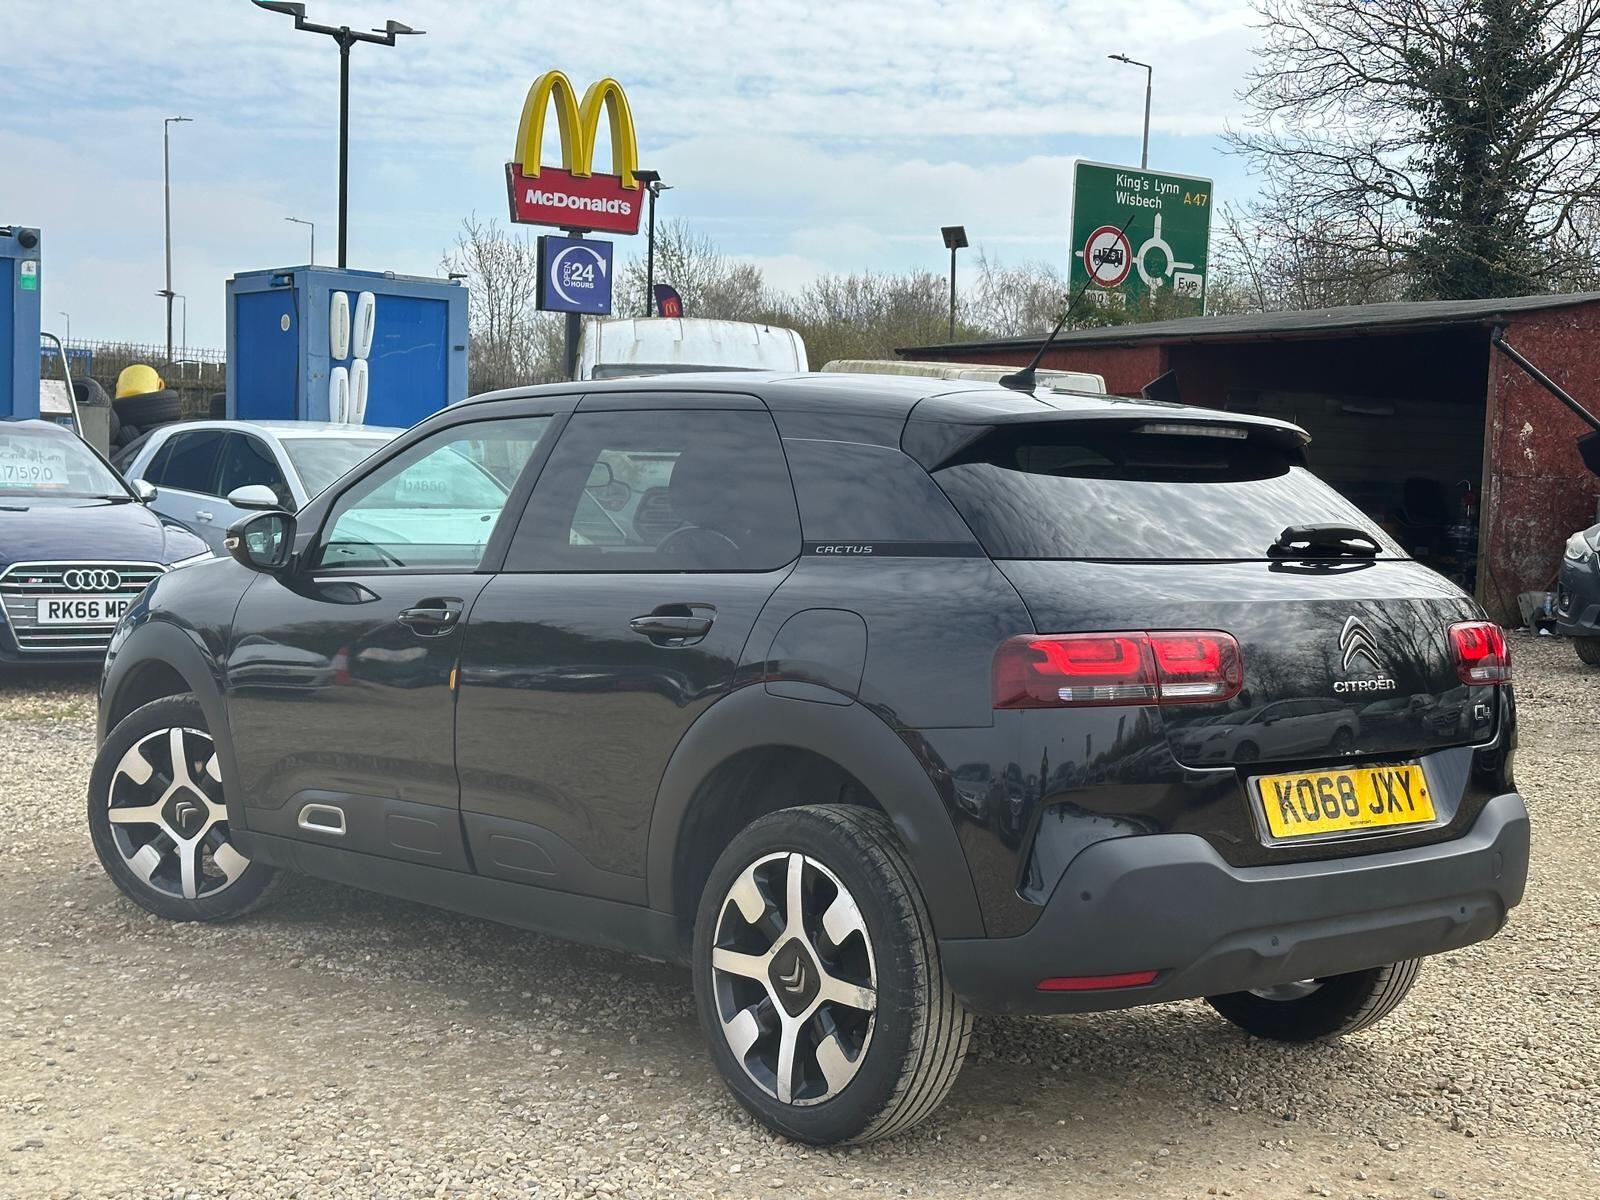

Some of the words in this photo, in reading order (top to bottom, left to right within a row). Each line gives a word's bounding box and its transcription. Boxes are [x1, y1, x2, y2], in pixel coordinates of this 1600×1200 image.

[1116, 173, 1149, 191] King's
[1155, 178, 1180, 195] Lynn
[525, 188, 632, 216] McDonald's
[1115, 190, 1162, 209] Wisbech
[563, 261, 571, 287] OPEN
[571, 262, 595, 282] 24
[570, 281, 595, 289] HOURS
[1178, 277, 1198, 291] Eye
[815, 545, 873, 554] CACTUS
[48, 601, 100, 619] RK66
[1333, 674, 1396, 693] CITROËN
[1273, 775, 1359, 826] KO68
[1368, 770, 1416, 815] JXY
